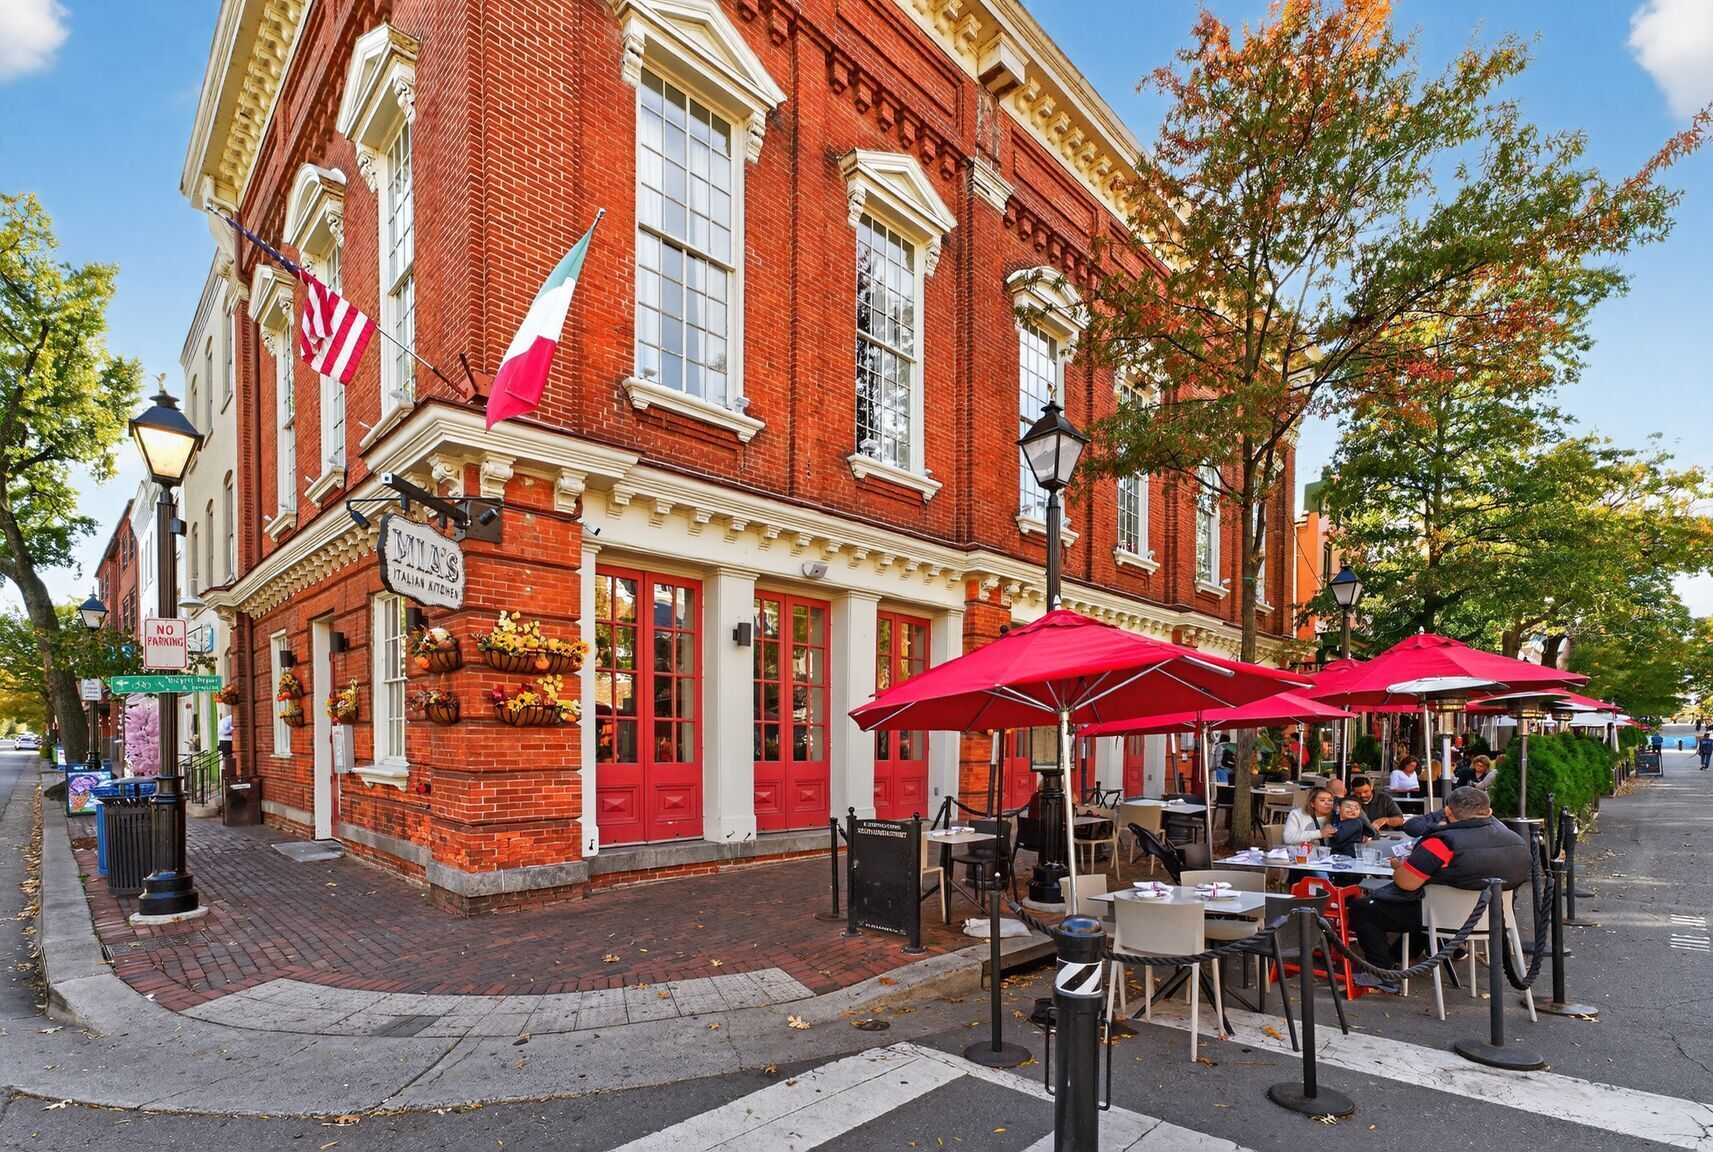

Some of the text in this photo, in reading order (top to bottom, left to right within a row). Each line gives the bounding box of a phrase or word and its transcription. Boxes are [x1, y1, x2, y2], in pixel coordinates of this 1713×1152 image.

[392, 528, 459, 583] MIA'S
[393, 568, 459, 600] ITALIAN KITCHEN
[157, 625, 174, 635] NO
[147, 637, 184, 647] PARKING
